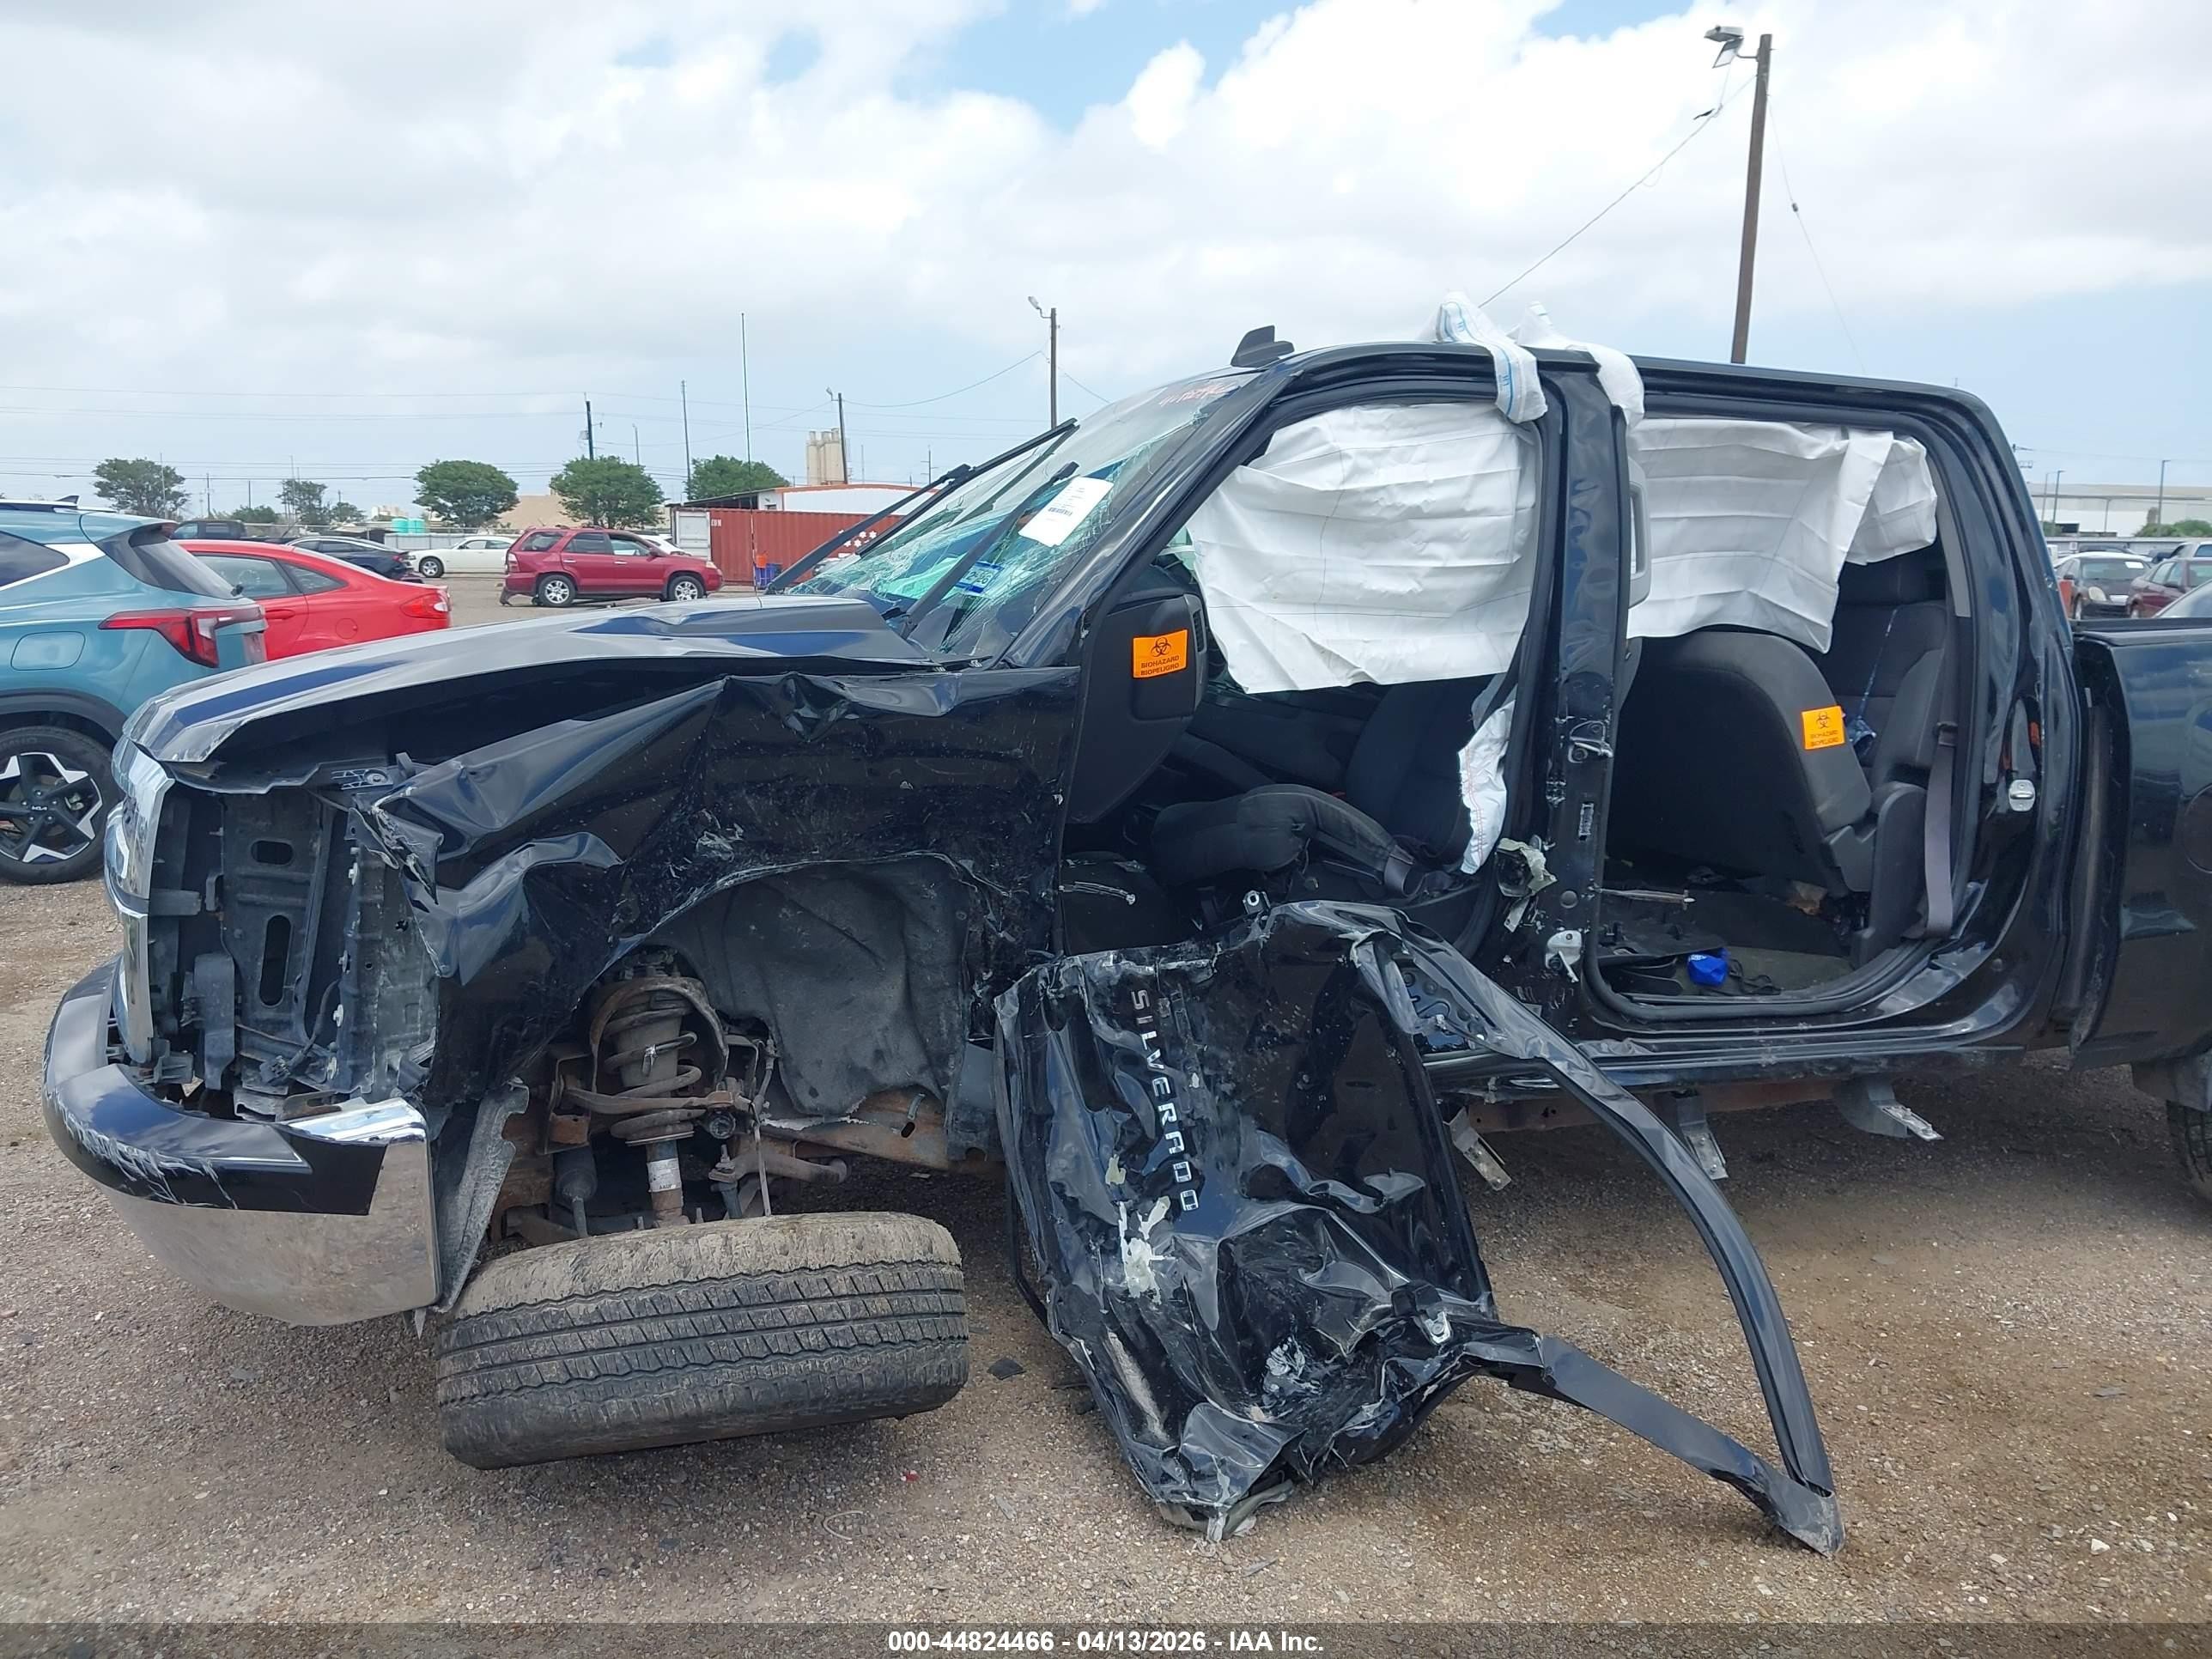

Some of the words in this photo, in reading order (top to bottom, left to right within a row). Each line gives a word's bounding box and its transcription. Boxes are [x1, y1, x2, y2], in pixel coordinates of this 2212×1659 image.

[1140, 655, 1180, 669] BIOHAZARD
[1140, 662, 1180, 676] BIOPELIGRO
[1130, 989, 1199, 1212] SILVERADO
